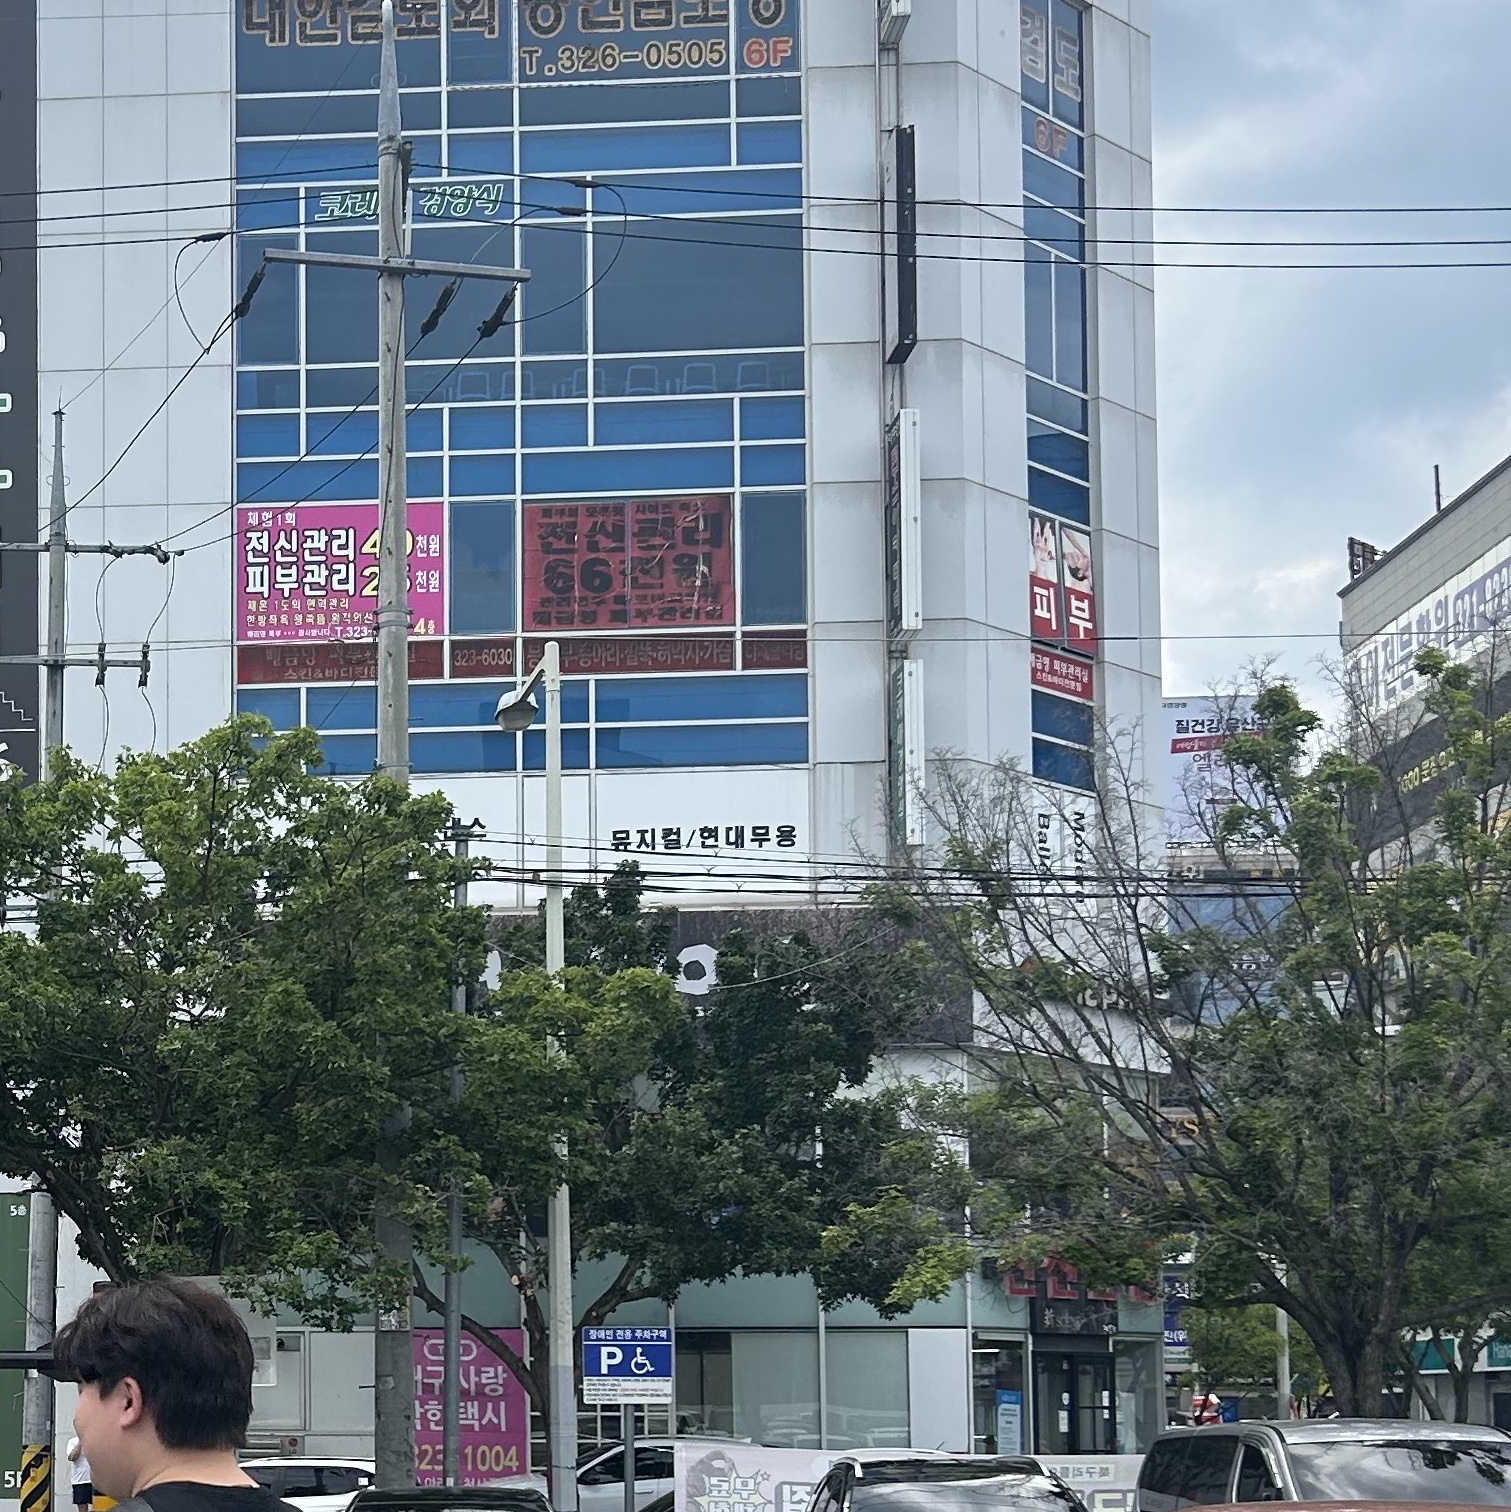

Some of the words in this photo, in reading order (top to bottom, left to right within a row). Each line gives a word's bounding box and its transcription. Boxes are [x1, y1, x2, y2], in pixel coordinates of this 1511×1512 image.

[743, 36, 793, 69] 6F
[244, 563, 356, 598] 피부관리
[454, 648, 513, 667] 323-6030
[610, 825, 797, 851] 뮤지컬/현대무용
[589, 1329, 614, 1340] 장애인
[616, 1329, 632, 1340] 전용
[635, 1329, 667, 1340] 주차구역
[600, 1346, 624, 1375] P
[464, 1444, 520, 1472] 1004
